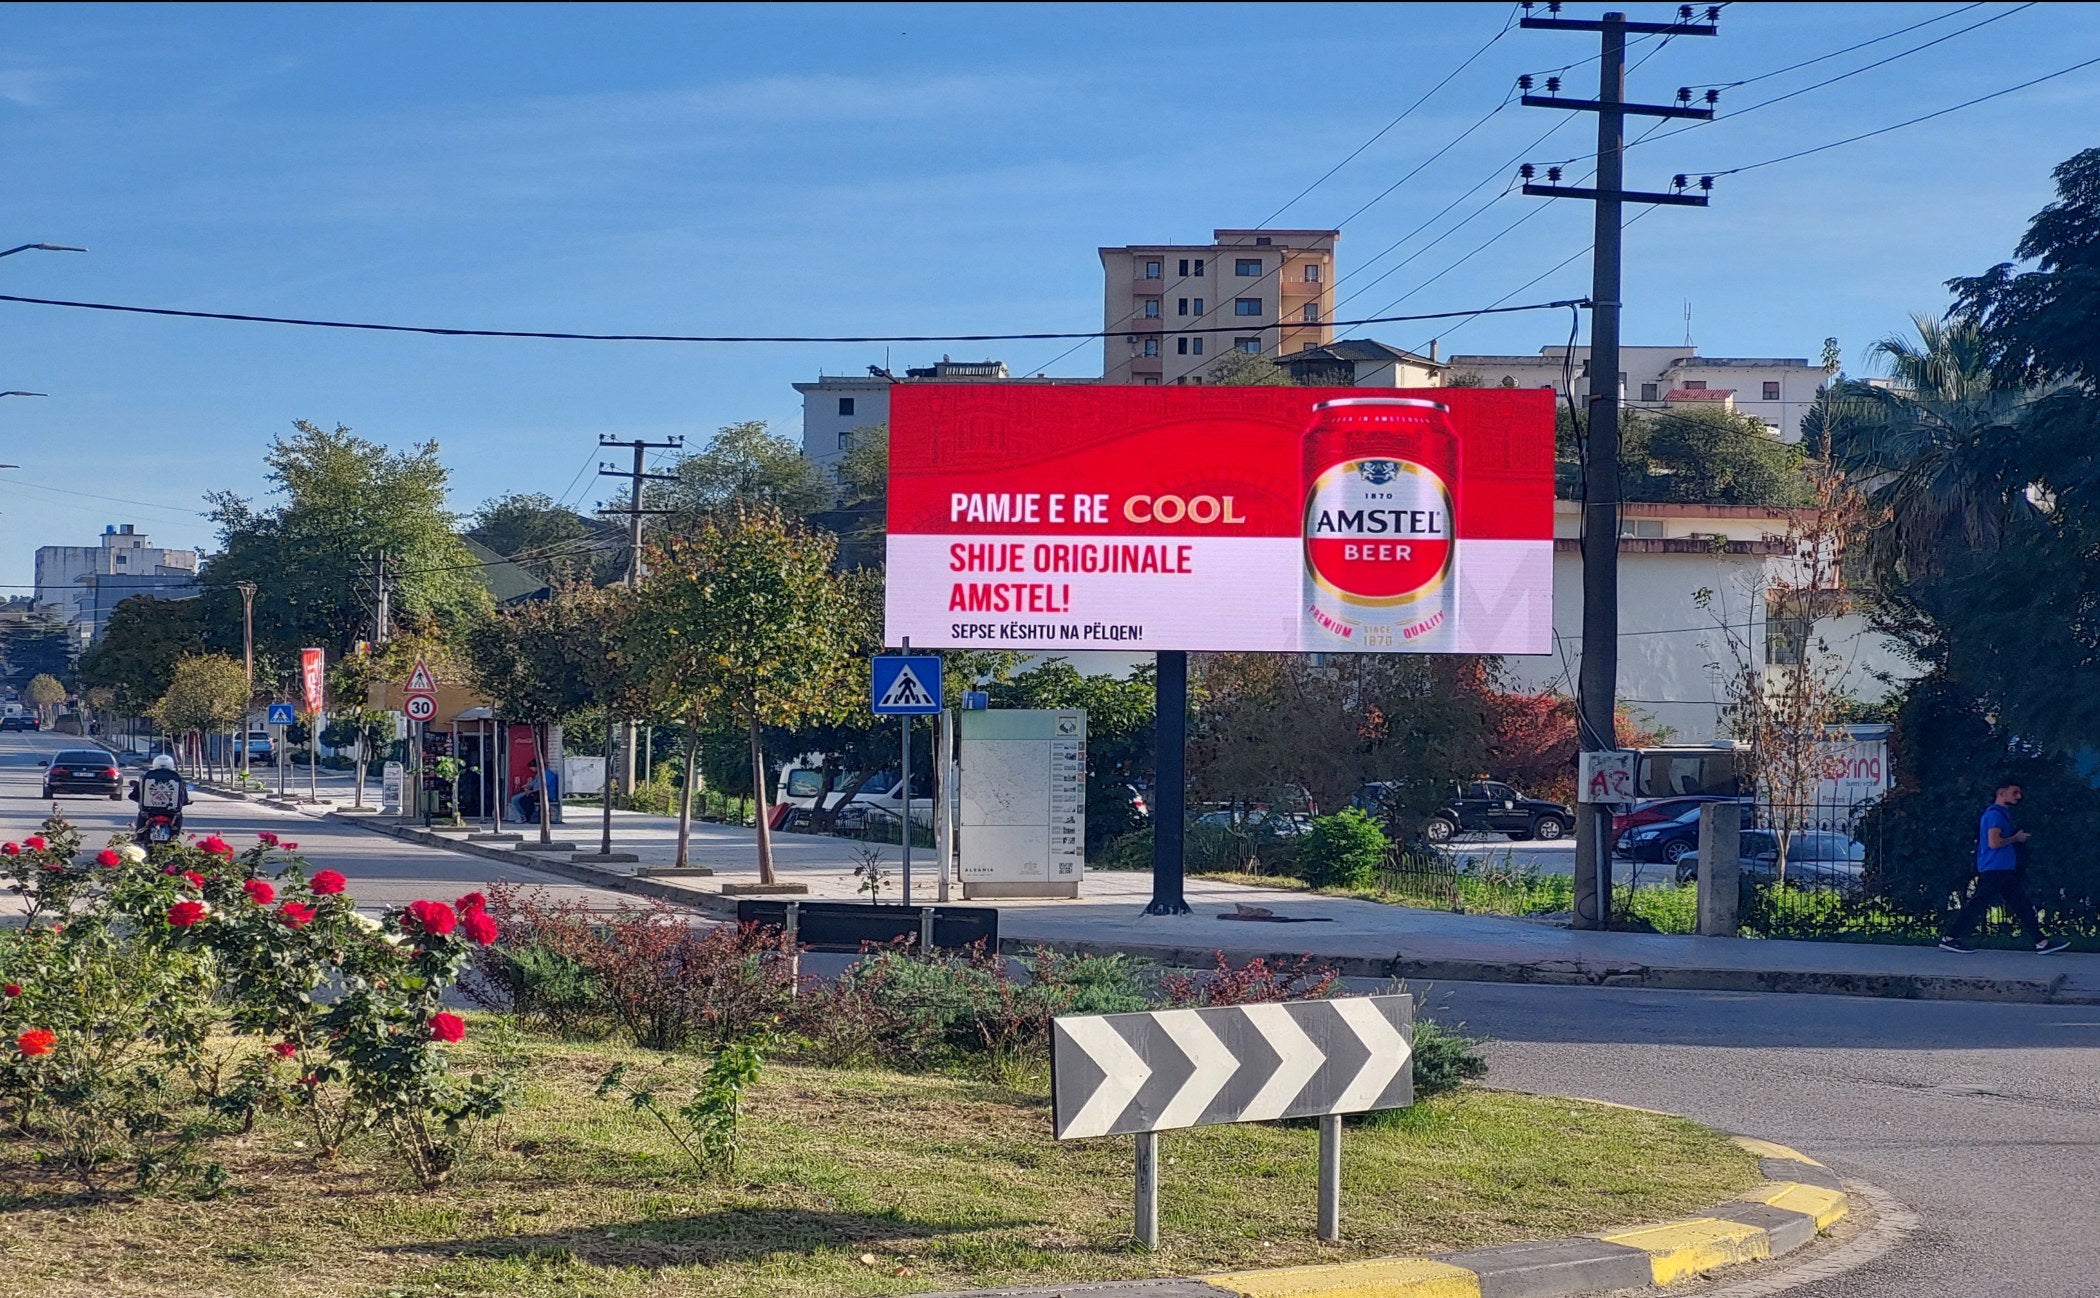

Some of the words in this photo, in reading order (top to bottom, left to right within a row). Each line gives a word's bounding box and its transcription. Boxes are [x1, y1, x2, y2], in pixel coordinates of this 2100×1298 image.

[950, 493, 1041, 523] PAMJE
[1049, 494, 1065, 523] E
[1073, 494, 1109, 523] RE
[1123, 494, 1246, 524] COOL
[949, 543, 1026, 573] SHIJE
[1033, 544, 1192, 574] ORIGJINALE
[1344, 544, 1412, 561] BEER
[948, 583, 1070, 613] AMSTEL!
[951, 623, 996, 639] SEPSE
[1000, 621, 1056, 640] KËSHTU
[1060, 624, 1080, 640] NA
[1084, 622, 1143, 641] PËLQEN!
[1308, 604, 1353, 639] PREMIUM
[1363, 625, 1391, 634] SINCE
[1403, 610, 1446, 639] QUALITY
[1363, 635, 1392, 646] 1870
[411, 701, 430, 714] 30
